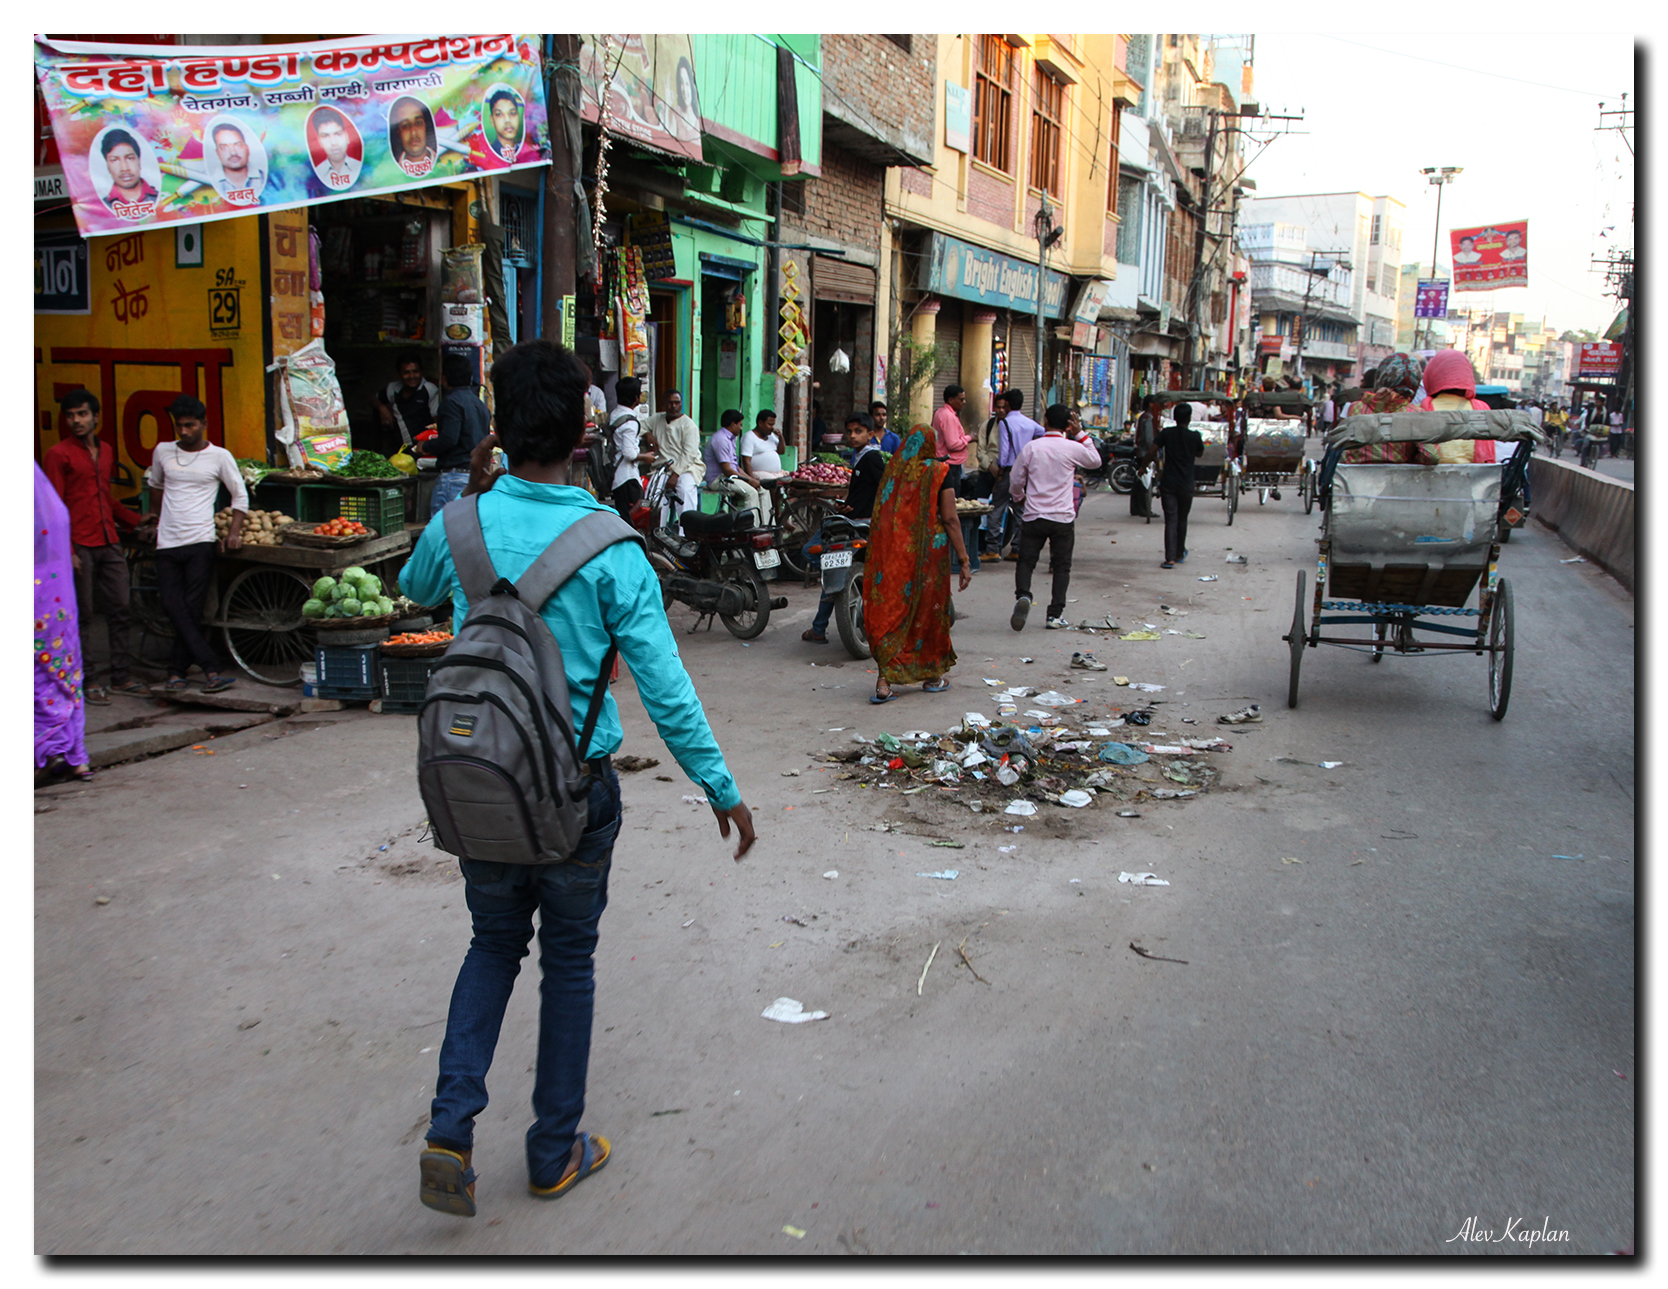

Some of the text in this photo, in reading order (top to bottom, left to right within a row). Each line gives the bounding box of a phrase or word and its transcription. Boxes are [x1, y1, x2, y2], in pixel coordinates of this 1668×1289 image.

[264, 86, 314, 104] सब्जी
[320, 81, 368, 99] मण्डी,
[374, 73, 443, 92] वाराणसी
[330, 172, 350, 187] शिव
[113, 202, 154, 219] जितेन्द्र
[226, 188, 259, 203] बबलू
[963, 248, 999, 297] Bright
[999, 260, 1033, 302] English
[111, 279, 151, 325] पैक
[213, 291, 237, 324] 29
